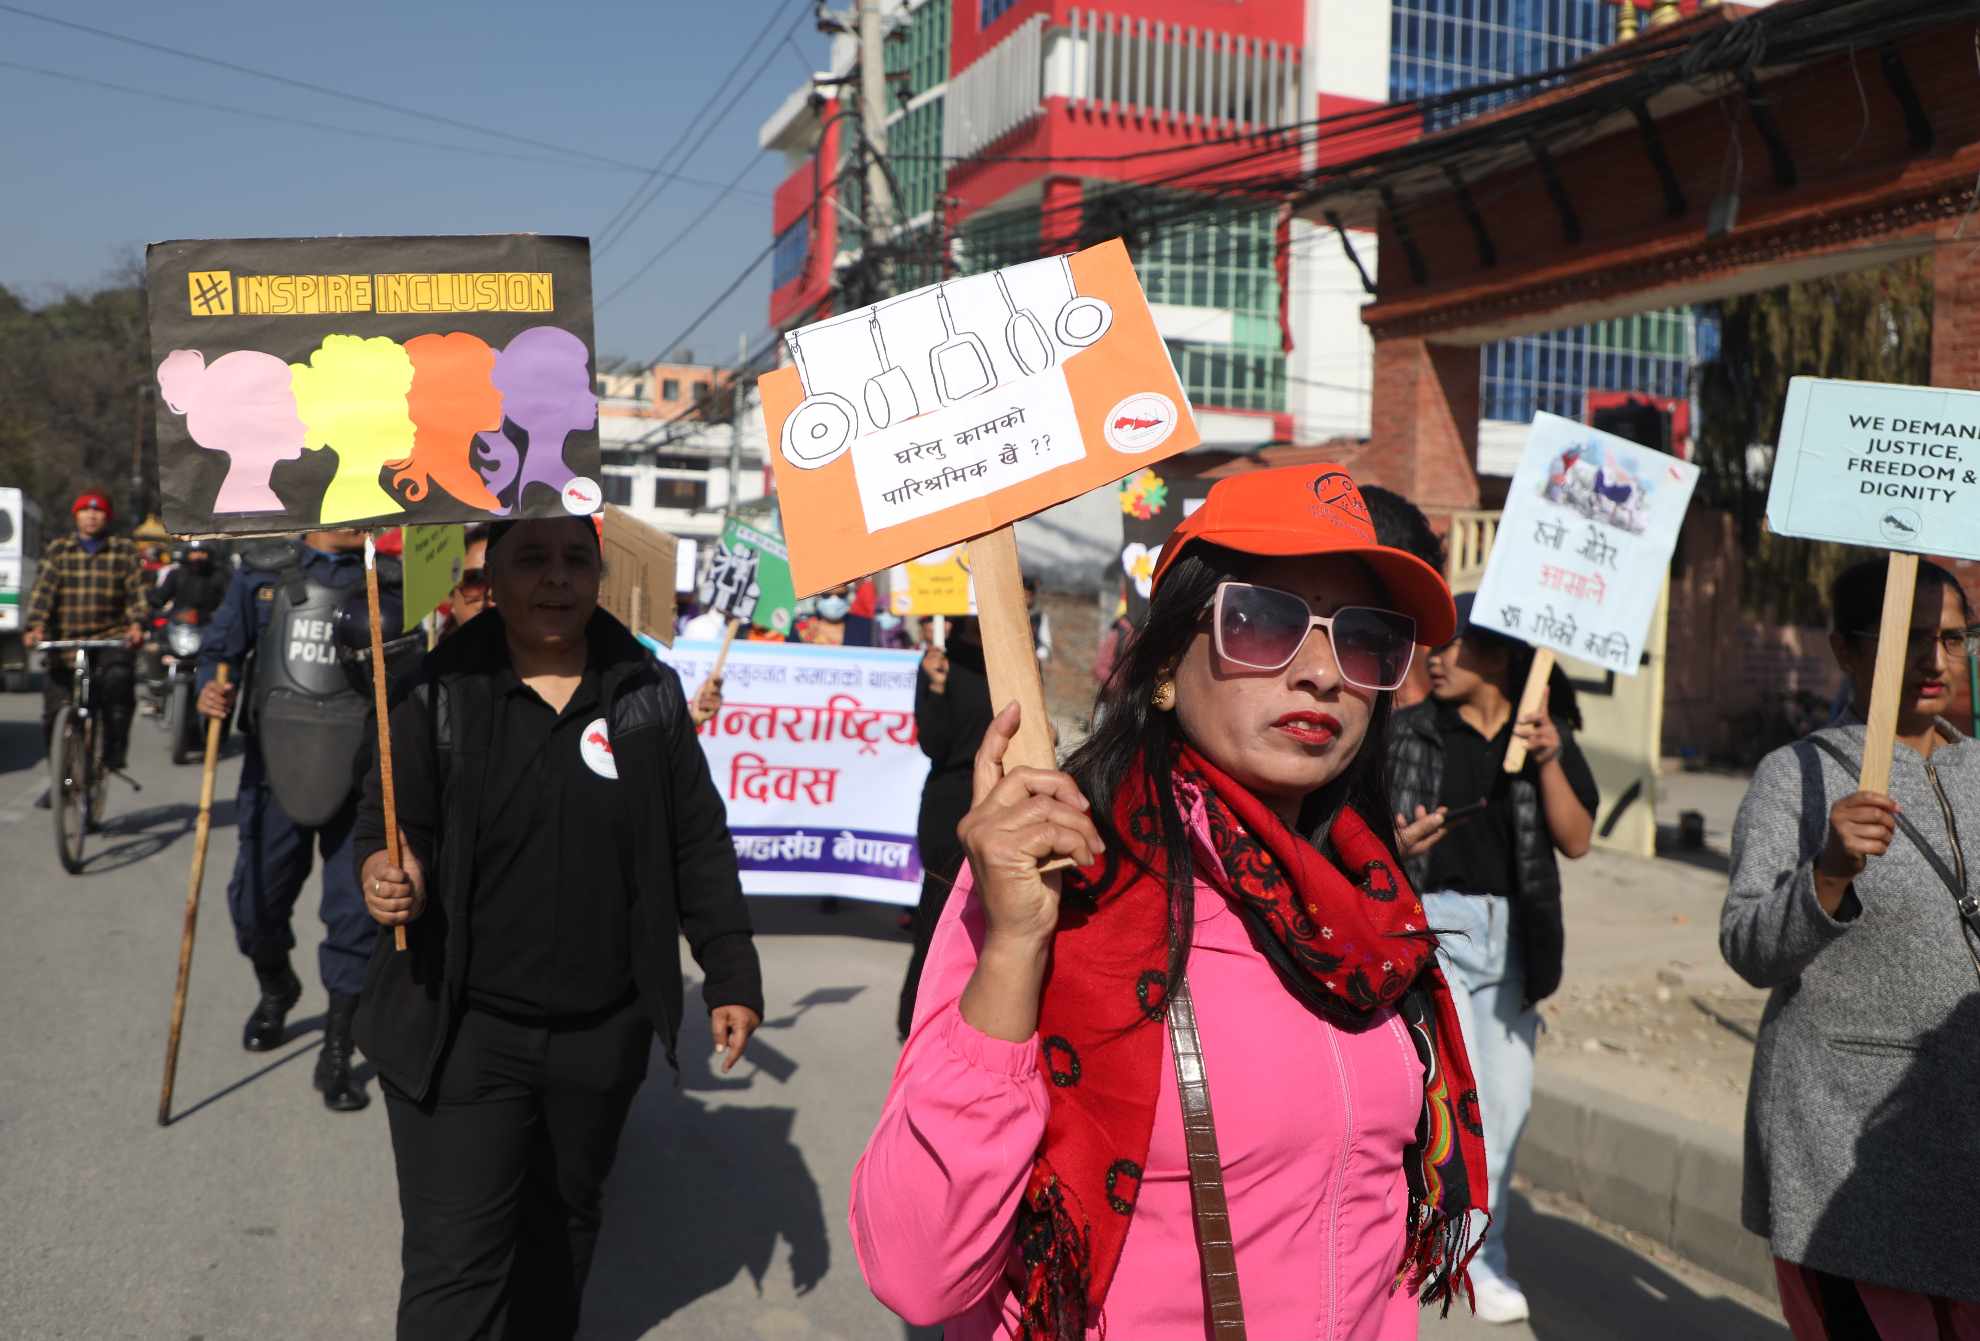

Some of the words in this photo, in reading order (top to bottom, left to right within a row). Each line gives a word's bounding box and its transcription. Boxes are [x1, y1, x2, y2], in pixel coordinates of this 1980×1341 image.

[376, 272, 552, 313] INCLUSION
[894, 438, 947, 464] घरेलु
[954, 406, 1025, 446] कामको
[1848, 414, 1885, 432] WE
[1891, 418, 1980, 441] DEMAN
[1865, 437, 1963, 463] JUSTICE,
[882, 459, 988, 505] पारिश्रमिक
[1847, 457, 1955, 482] FREEDOM
[1961, 470, 1977, 485] &
[1859, 480, 1957, 504] DIGNITY
[288, 640, 337, 665] POLI
[729, 752, 840, 806] दिवस
[832, 830, 912, 868] नेपाल
